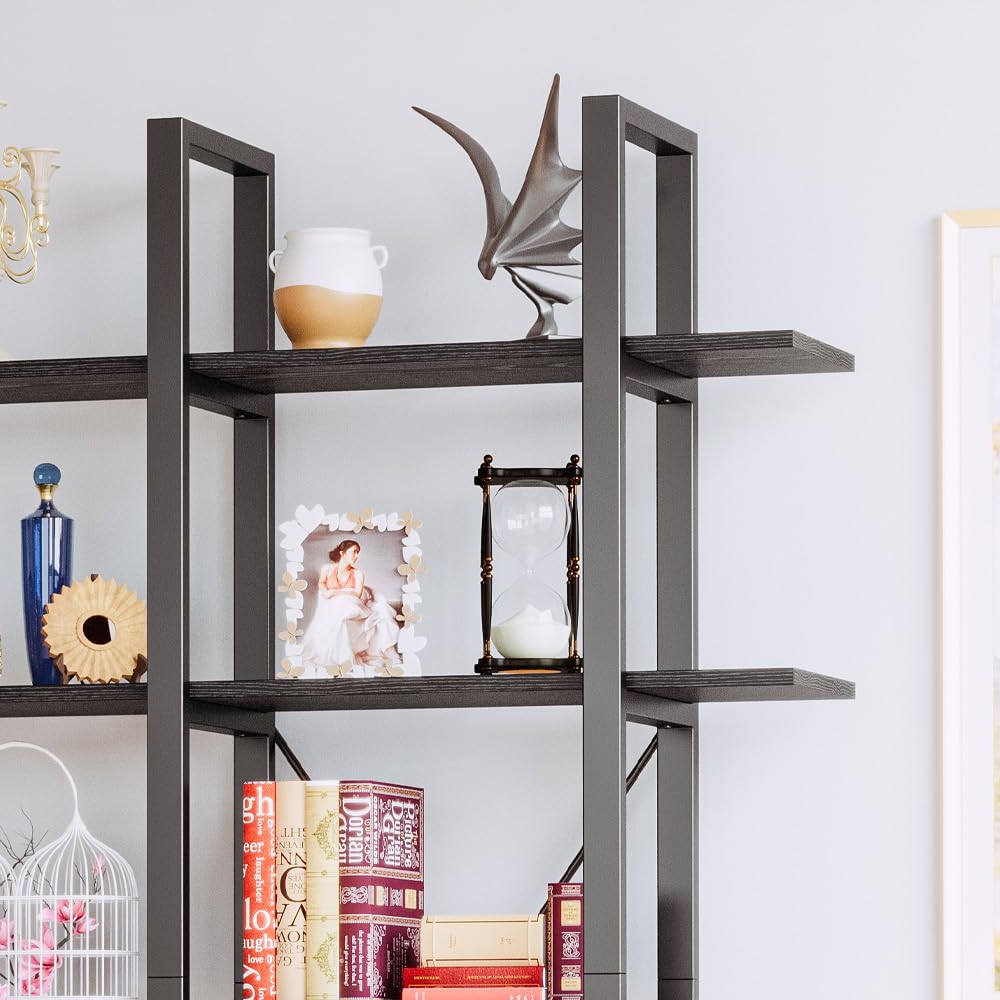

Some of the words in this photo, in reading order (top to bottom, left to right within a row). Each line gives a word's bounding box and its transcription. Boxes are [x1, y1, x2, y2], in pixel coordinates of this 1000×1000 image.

[257, 817, 265, 836] love
[343, 796, 371, 864] Dorian
[382, 814, 395, 866] Gray
[391, 800, 403, 867] Dorian
[403, 802, 415, 868] Picture
[254, 856, 265, 904] laughter
[247, 953, 264, 964] love
